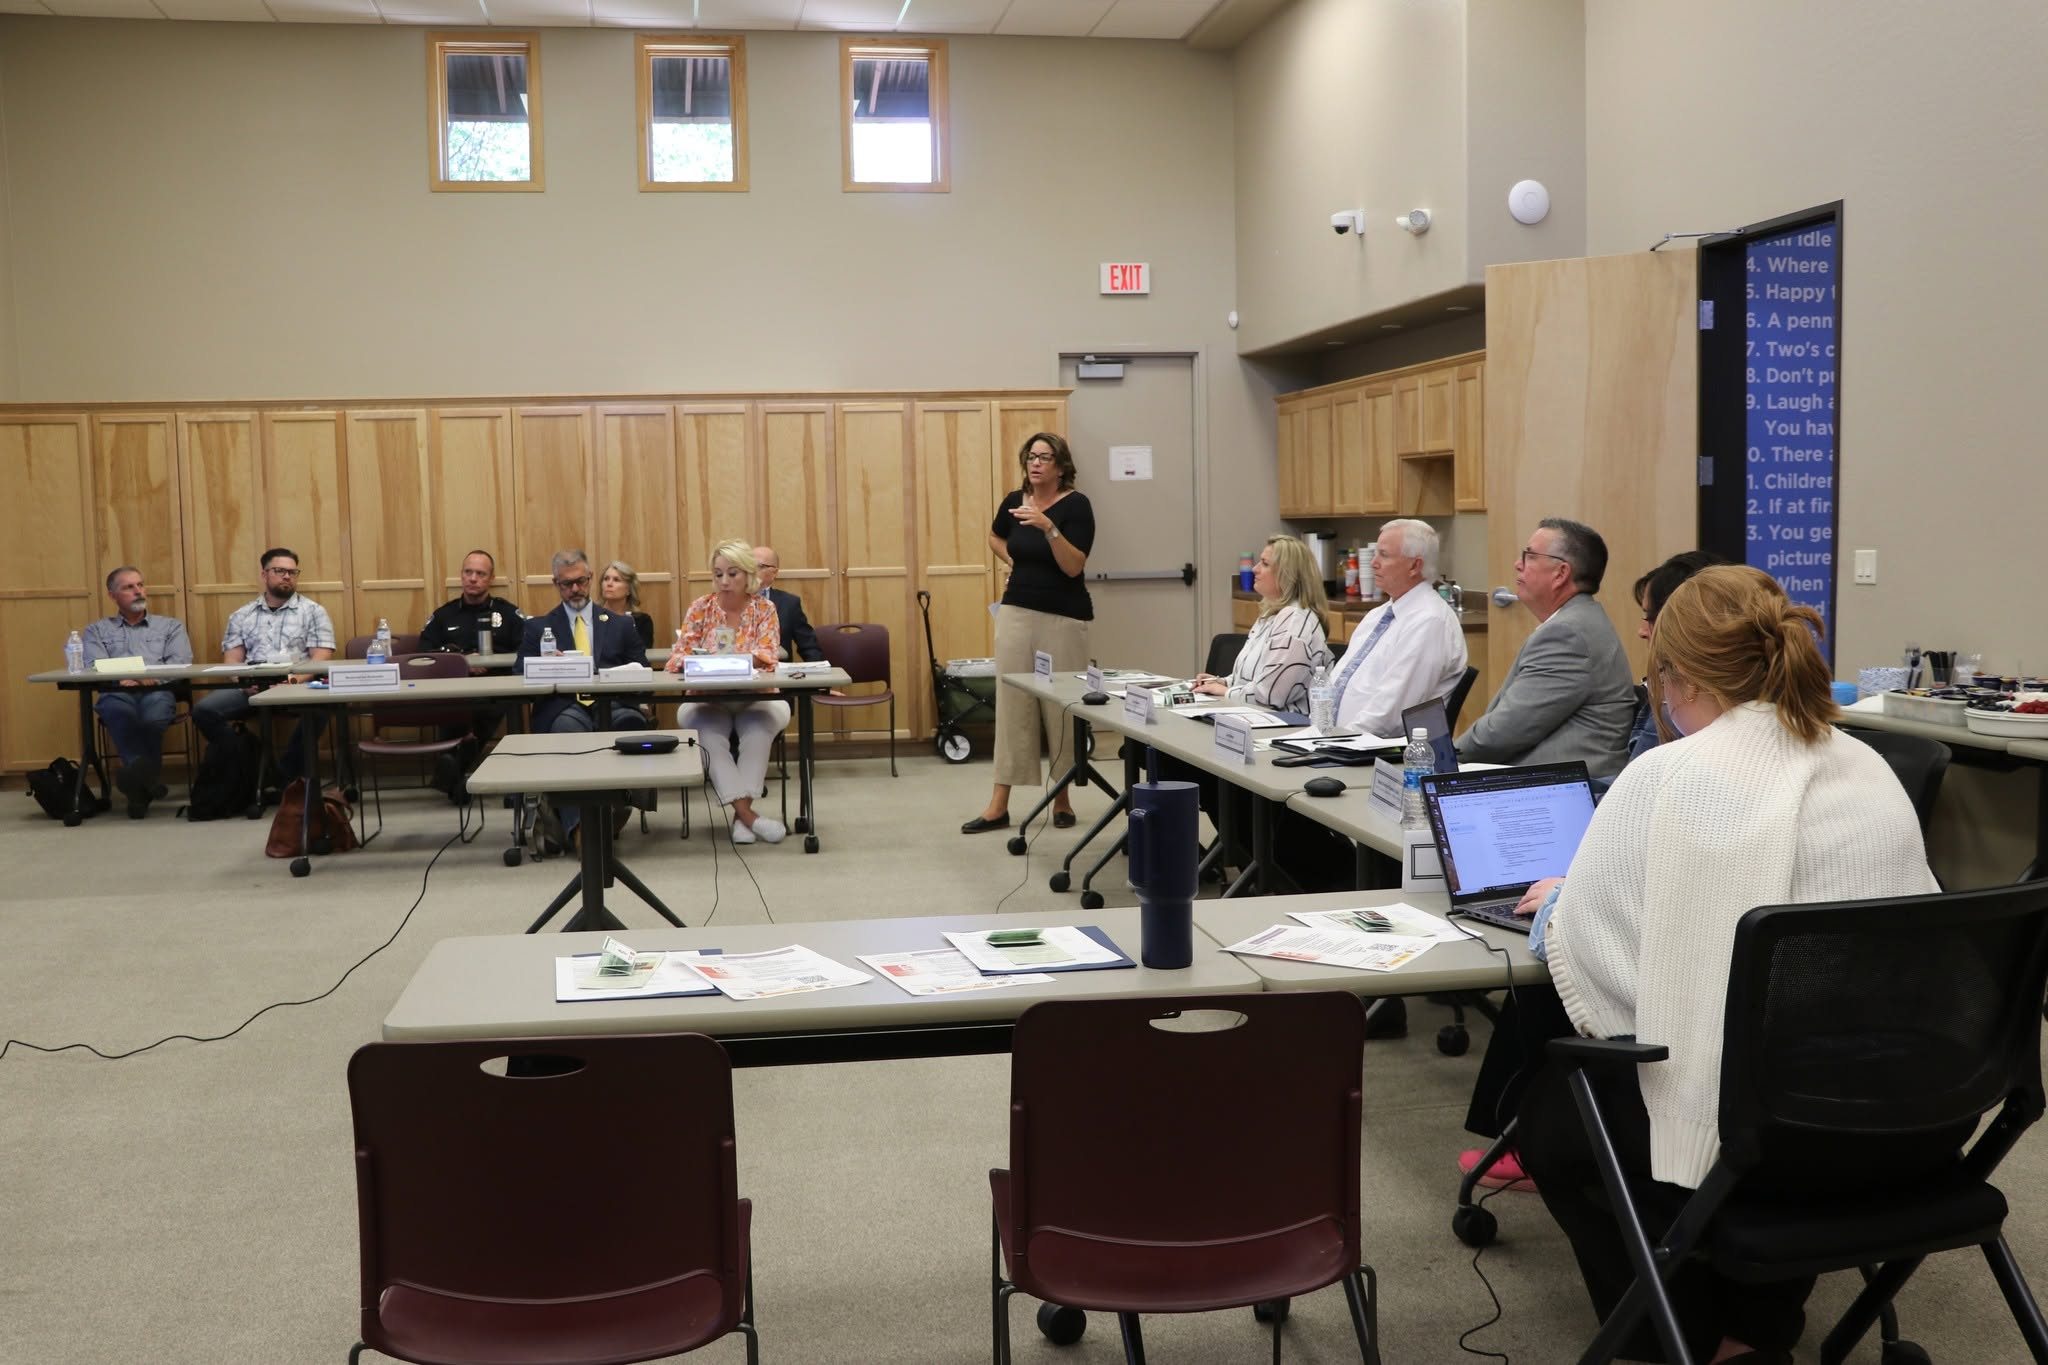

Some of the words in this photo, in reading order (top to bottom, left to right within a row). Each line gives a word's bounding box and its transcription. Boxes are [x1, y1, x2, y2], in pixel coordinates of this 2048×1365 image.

[1746, 256, 1761, 273] 4.
[1767, 256, 1829, 273] Where
[1110, 264, 1142, 291] EXIT
[1766, 283, 1825, 302] Happy
[1767, 312, 1781, 328] A
[1787, 315, 1834, 331] penn
[1766, 341, 1820, 357] Two's
[1766, 367, 1814, 383] Don't
[1767, 393, 1823, 412] Laugh
[1764, 419, 1800, 436] You
[1771, 445, 1823, 462] There
[1768, 498, 1783, 514] If
[1787, 499, 1805, 514] at
[1810, 497, 1832, 514] fir
[1768, 524, 1804, 540] You
[1809, 526, 1833, 542] ge
[1767, 549, 1832, 569] picture
